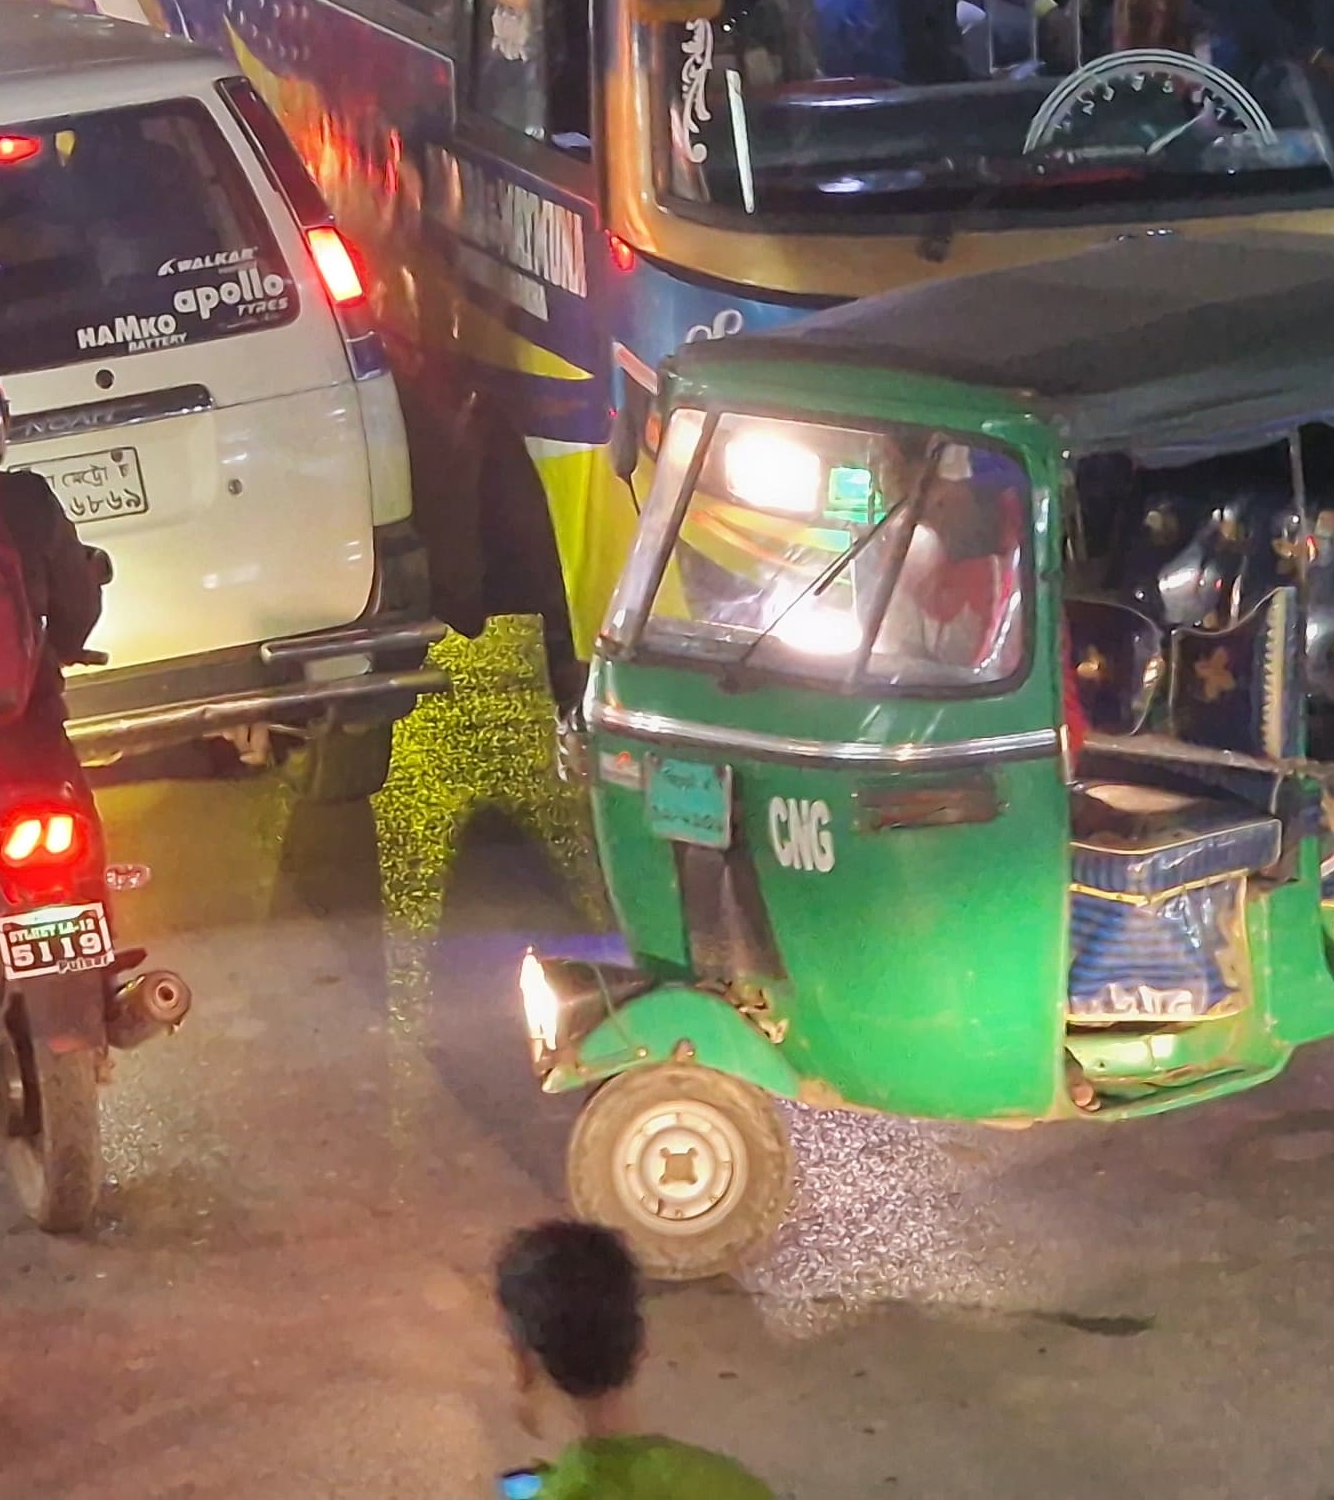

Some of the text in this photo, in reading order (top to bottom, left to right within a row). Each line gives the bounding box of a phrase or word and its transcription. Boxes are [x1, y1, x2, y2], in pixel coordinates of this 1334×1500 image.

[174, 268, 284, 320] apollo
[237, 297, 289, 317] TYRES
[129, 332, 188, 353] BATTERY
[25, 410, 114, 437] NOAH
[769, 796, 836, 873] CNG
[11, 932, 102, 967] 5119
